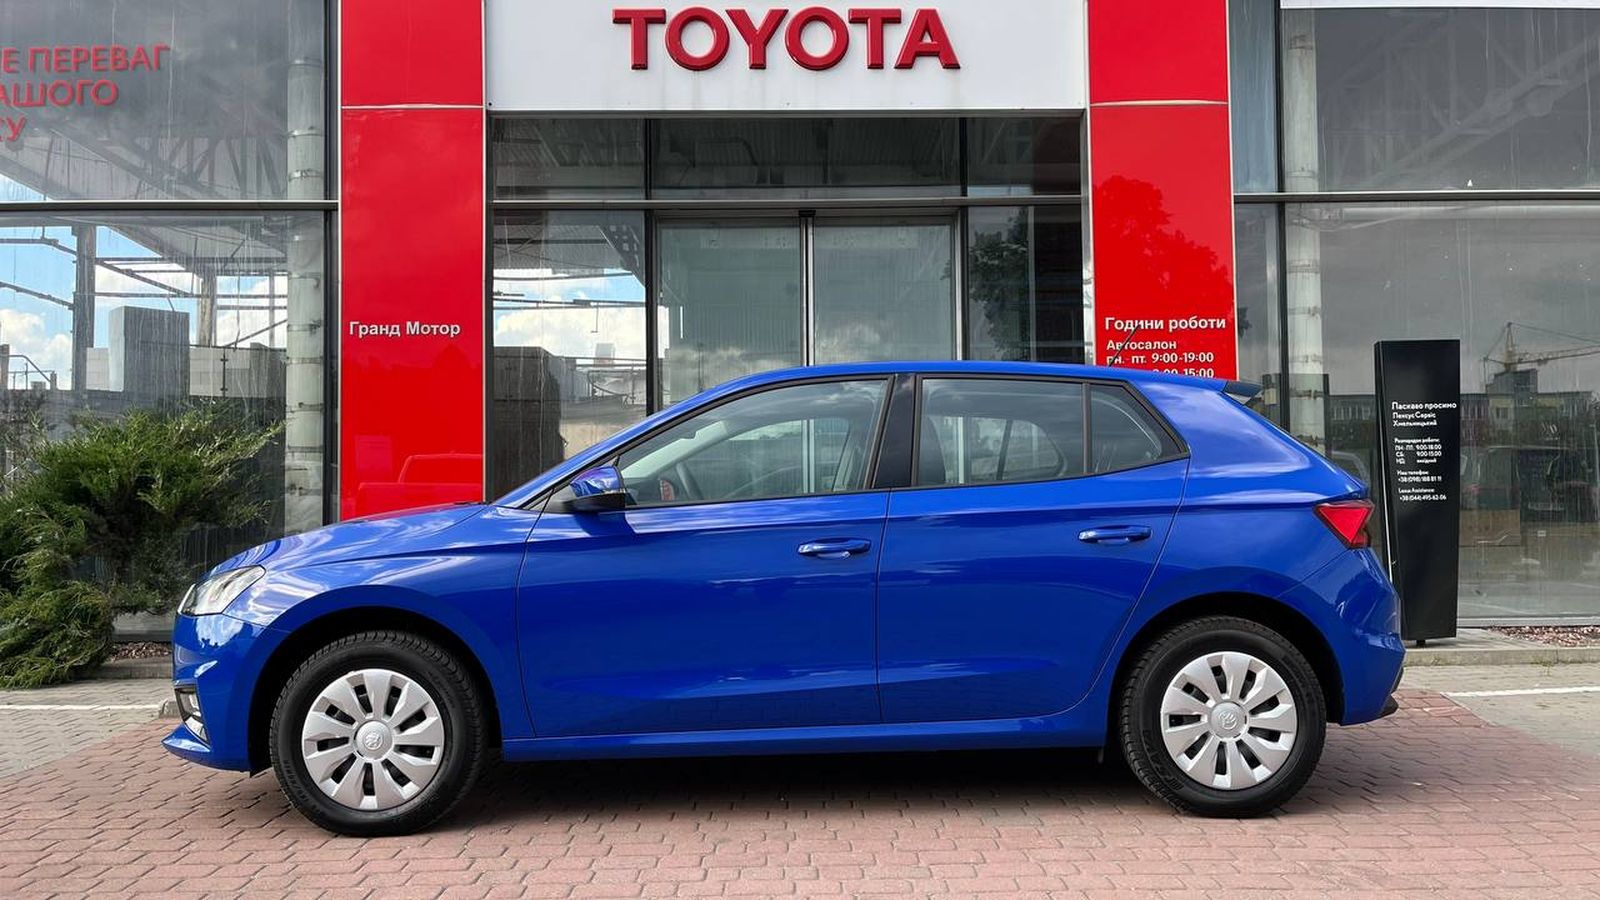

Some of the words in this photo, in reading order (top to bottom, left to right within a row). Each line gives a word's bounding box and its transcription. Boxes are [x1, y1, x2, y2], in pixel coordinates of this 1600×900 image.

[612, 6, 961, 71] TOYOTA
[28, 44, 171, 74] ПЕРЕВАГ
[349, 321, 401, 338] Гранд
[406, 321, 461, 338] Мотор
[1105, 317, 1164, 332] Години
[1168, 315, 1226, 332] роботи
[1106, 340, 1177, 351] Автосалон
